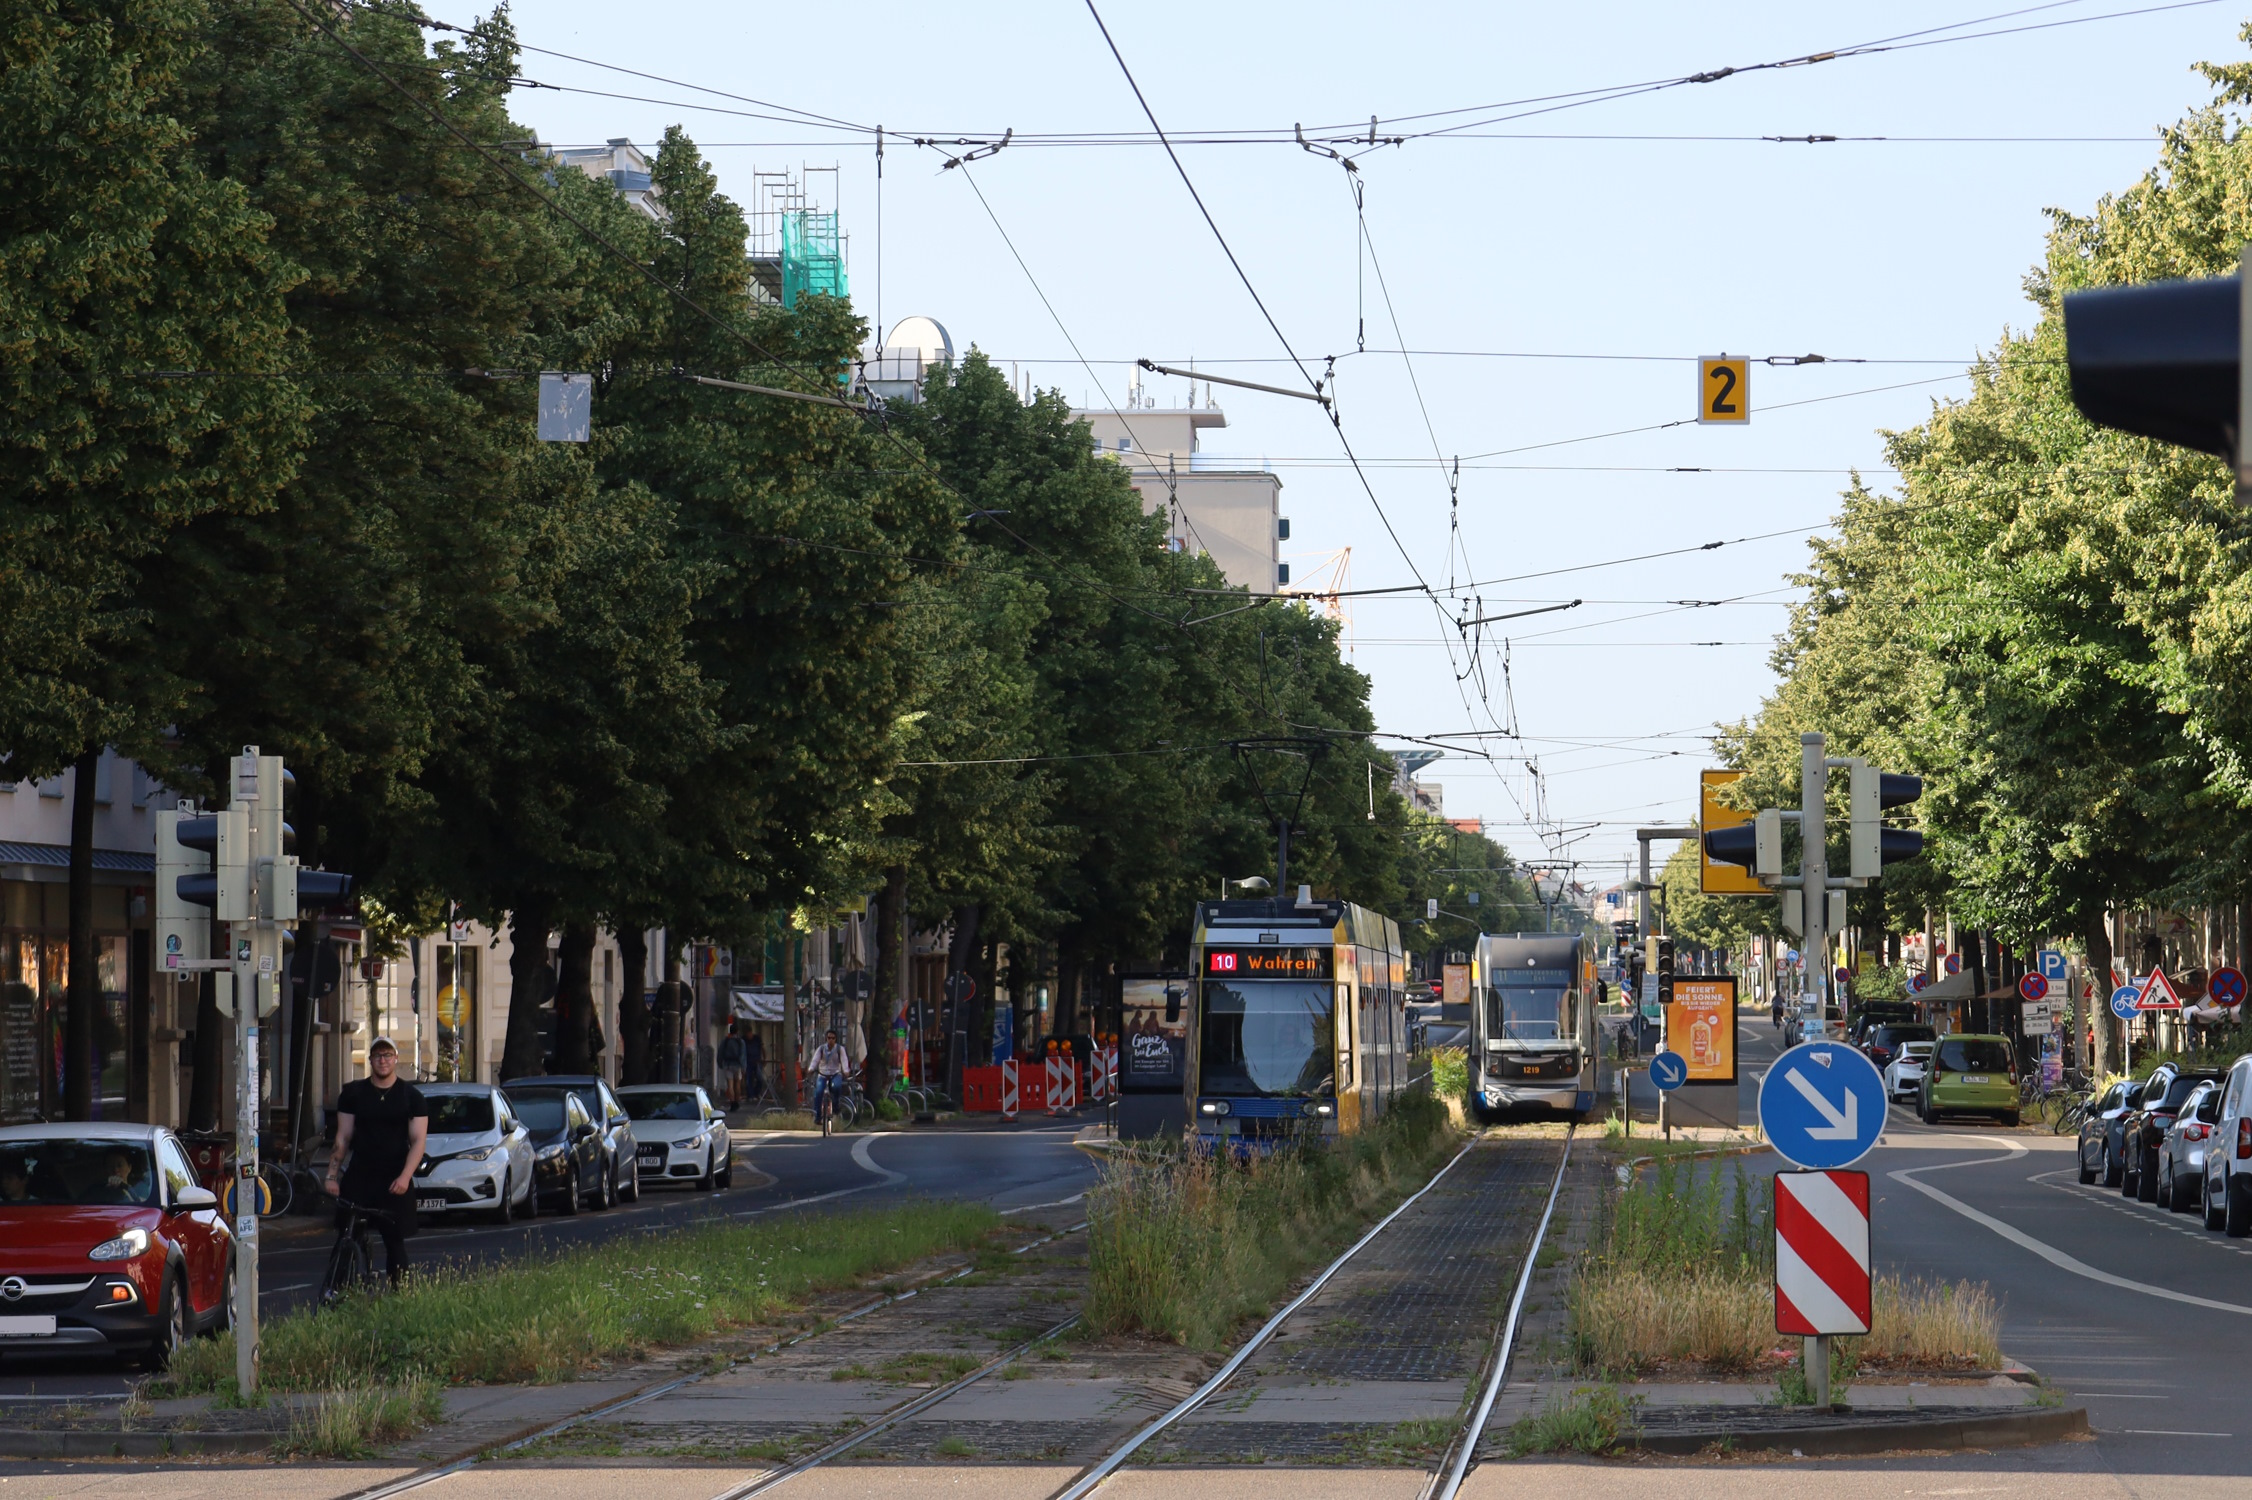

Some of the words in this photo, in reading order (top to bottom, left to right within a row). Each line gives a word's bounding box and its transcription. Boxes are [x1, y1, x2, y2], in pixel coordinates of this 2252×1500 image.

[1710, 366, 1736, 413] 2
[1216, 955, 1234, 969] 10
[1248, 955, 1316, 969] Wahren
[2045, 954, 2061, 976] P
[1692, 994, 1726, 1002] SONNE,
[1132, 1033, 1164, 1048] Ganz
[1134, 1047, 1145, 1056] bei
[1145, 1040, 1169, 1057] Euch
